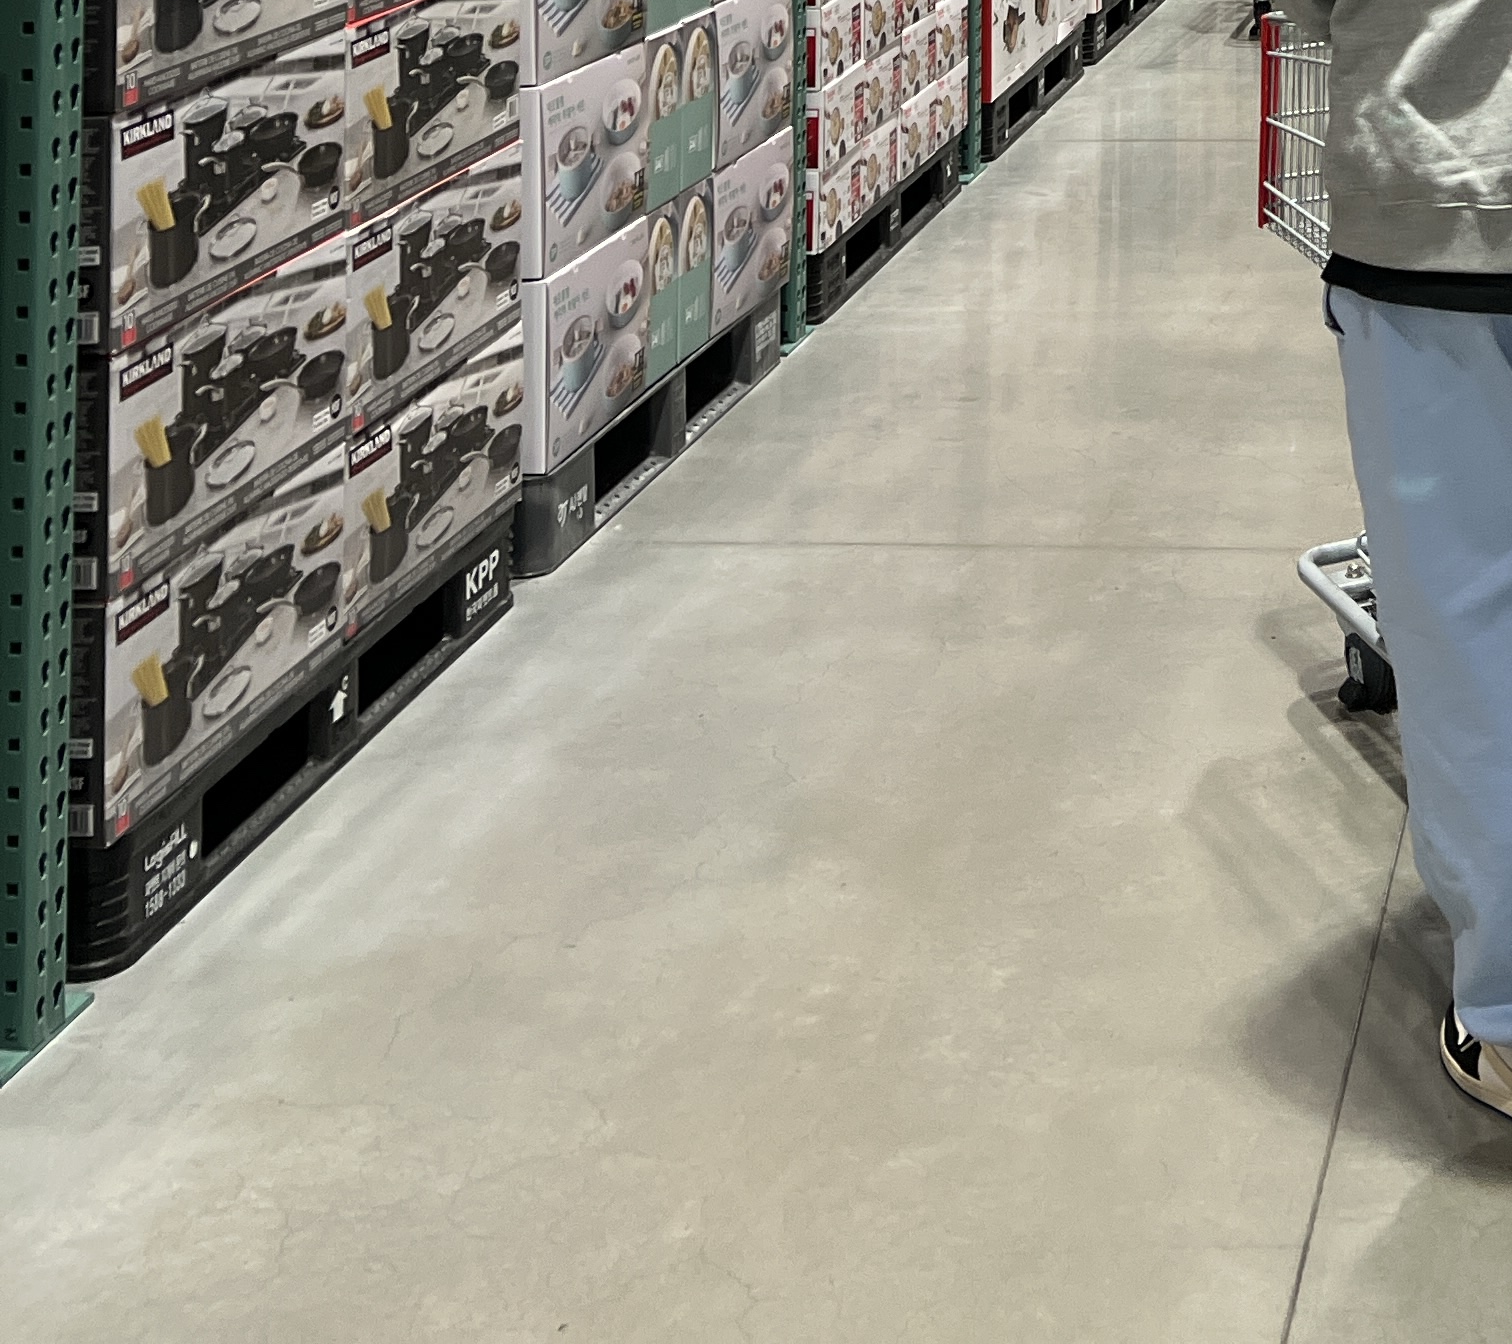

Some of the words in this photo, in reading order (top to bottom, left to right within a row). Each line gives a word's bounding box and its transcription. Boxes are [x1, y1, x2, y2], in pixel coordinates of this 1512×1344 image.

[122, 113, 173, 145] KIRKLAND
[121, 345, 172, 387] KIRKLAND
[465, 548, 500, 601] KPP
[118, 580, 169, 633] KIRKLAND
